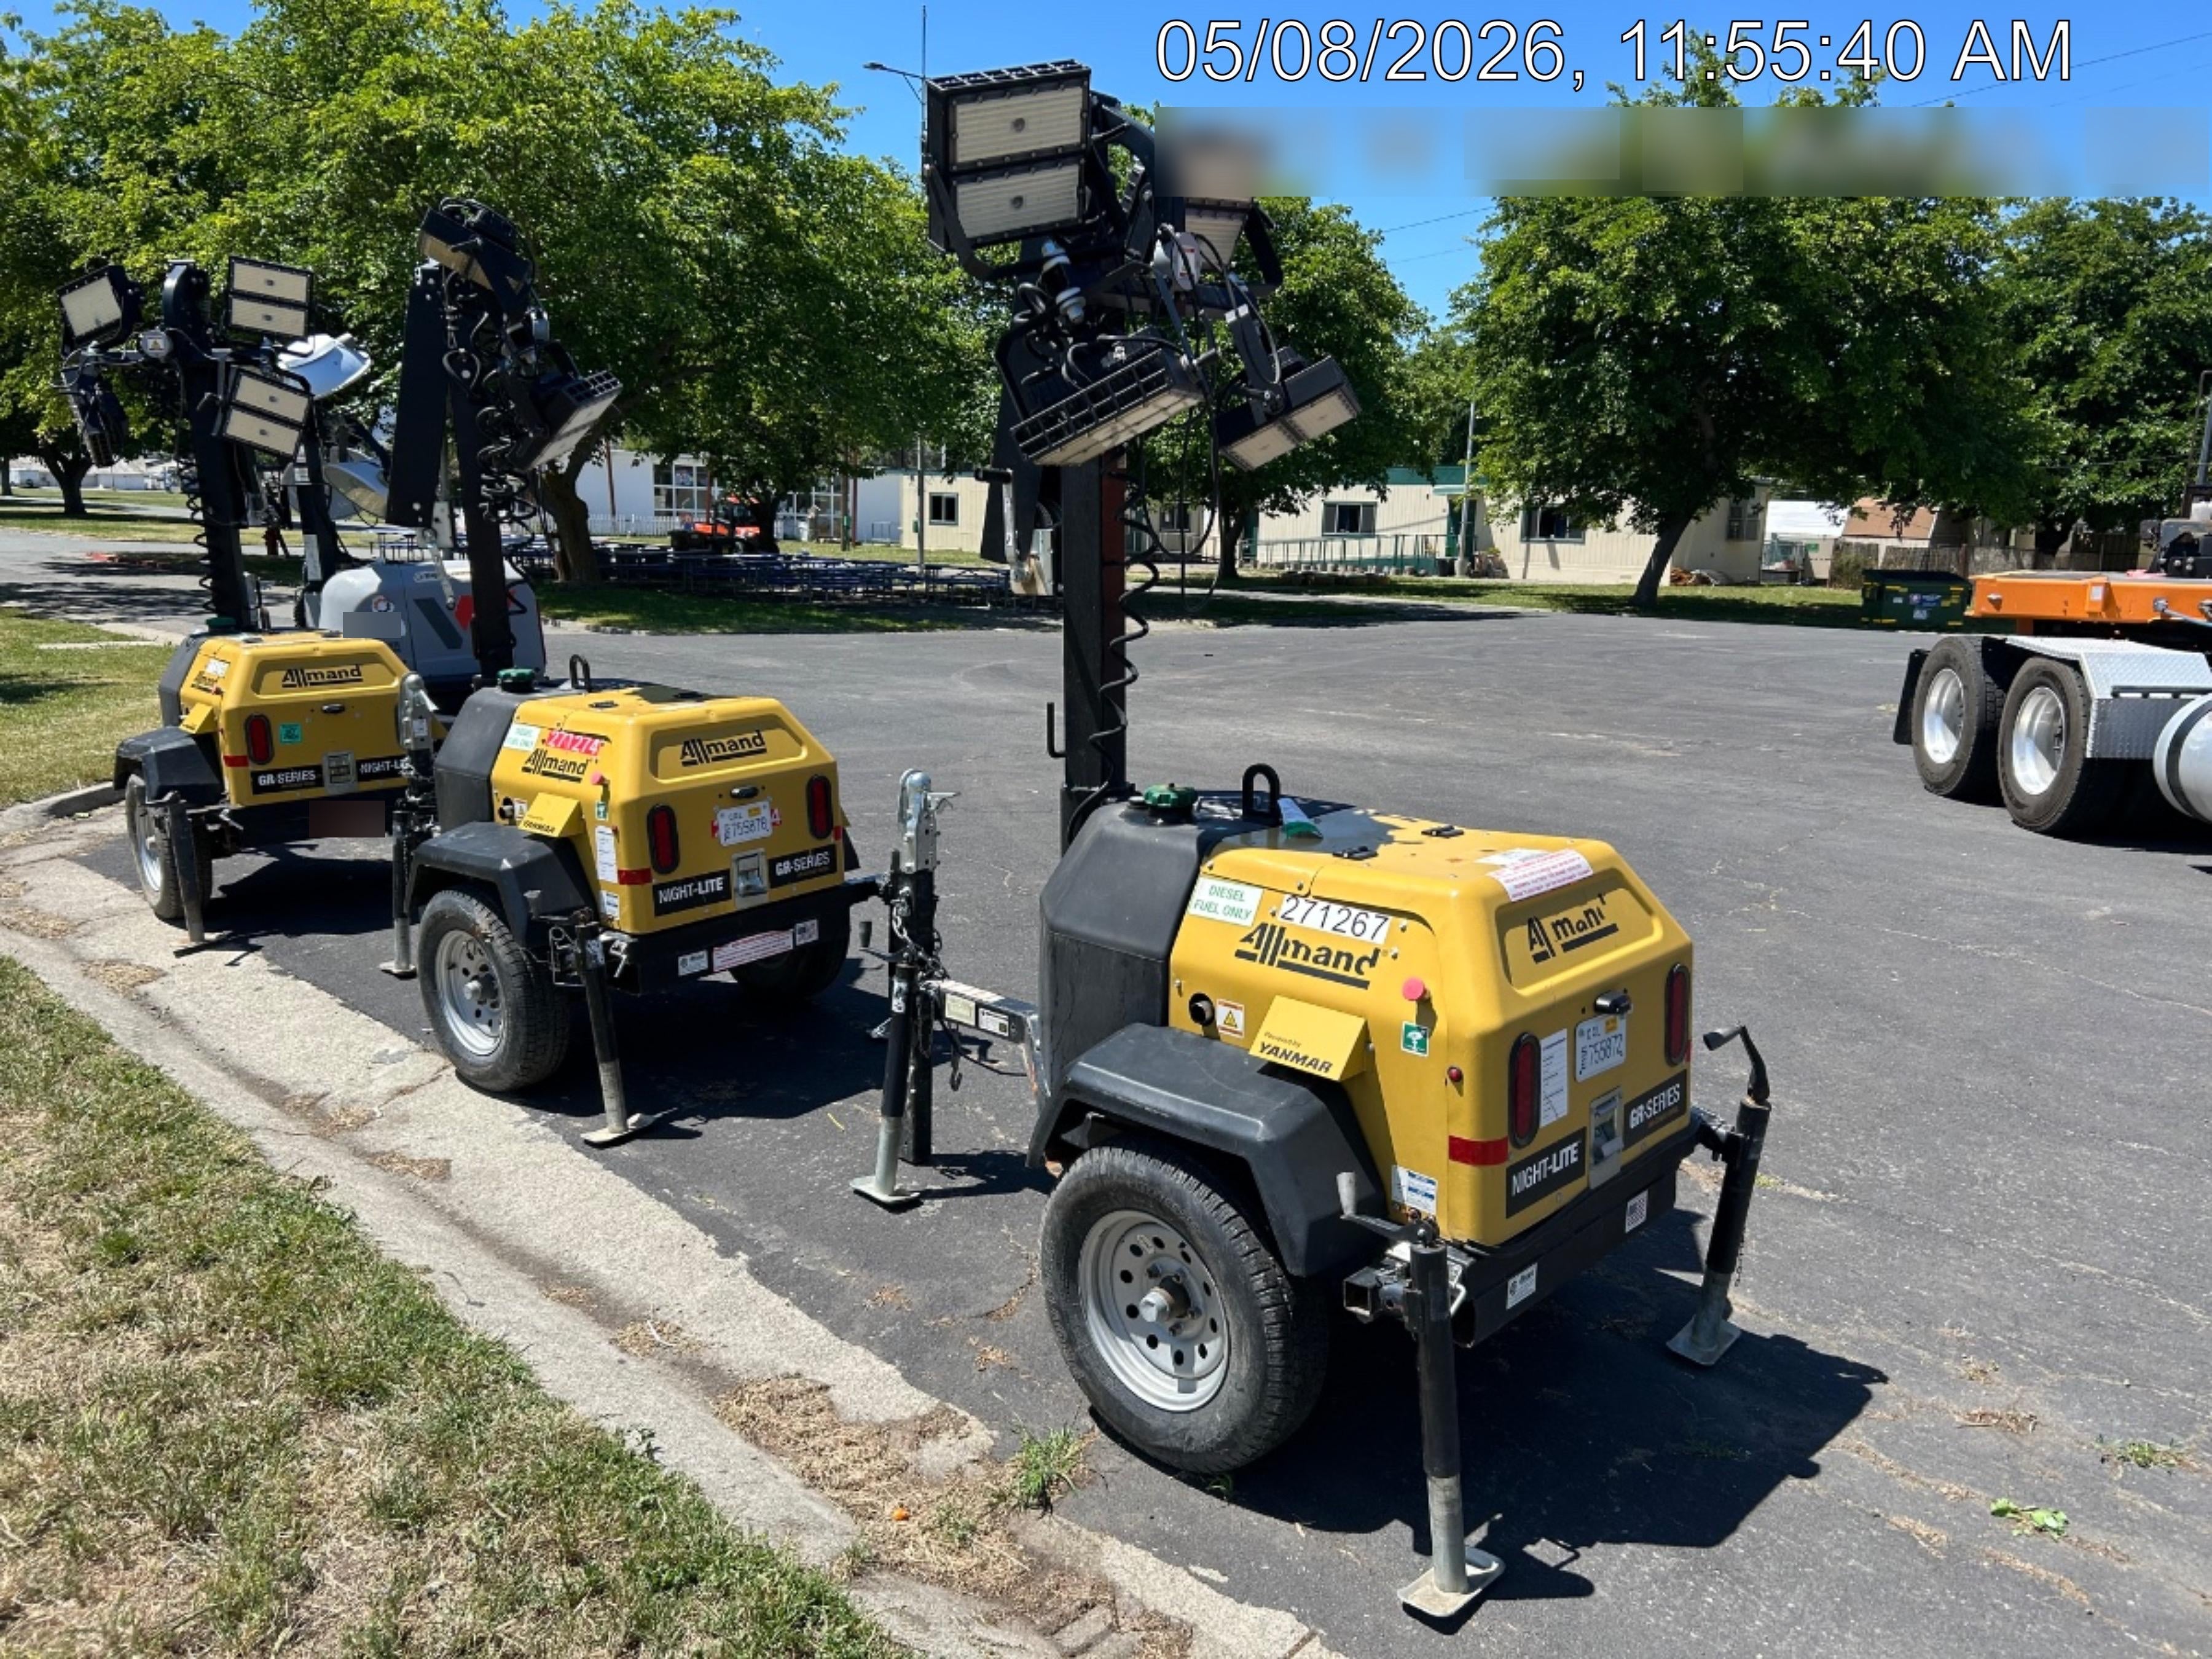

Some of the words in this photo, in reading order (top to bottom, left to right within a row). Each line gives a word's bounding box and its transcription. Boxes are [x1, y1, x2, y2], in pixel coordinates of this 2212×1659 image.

[281, 664, 363, 688] Allmand
[548, 731, 600, 754] 271274
[680, 730, 766, 764] Allmand
[522, 748, 588, 774] Allmand
[775, 851, 830, 876] GR-SERIES
[659, 876, 724, 904] NIGHT-LITE
[1209, 884, 1245, 902] DIESEL
[1193, 898, 1219, 914] FUEL
[1222, 904, 1252, 920] ONLY
[1281, 896, 1389, 940] 271267
[1260, 1041, 1333, 1073] YANMAR
[1630, 1084, 1681, 1129] GR-SERIES
[1512, 1142, 1580, 1196] NIGHT-LITE
